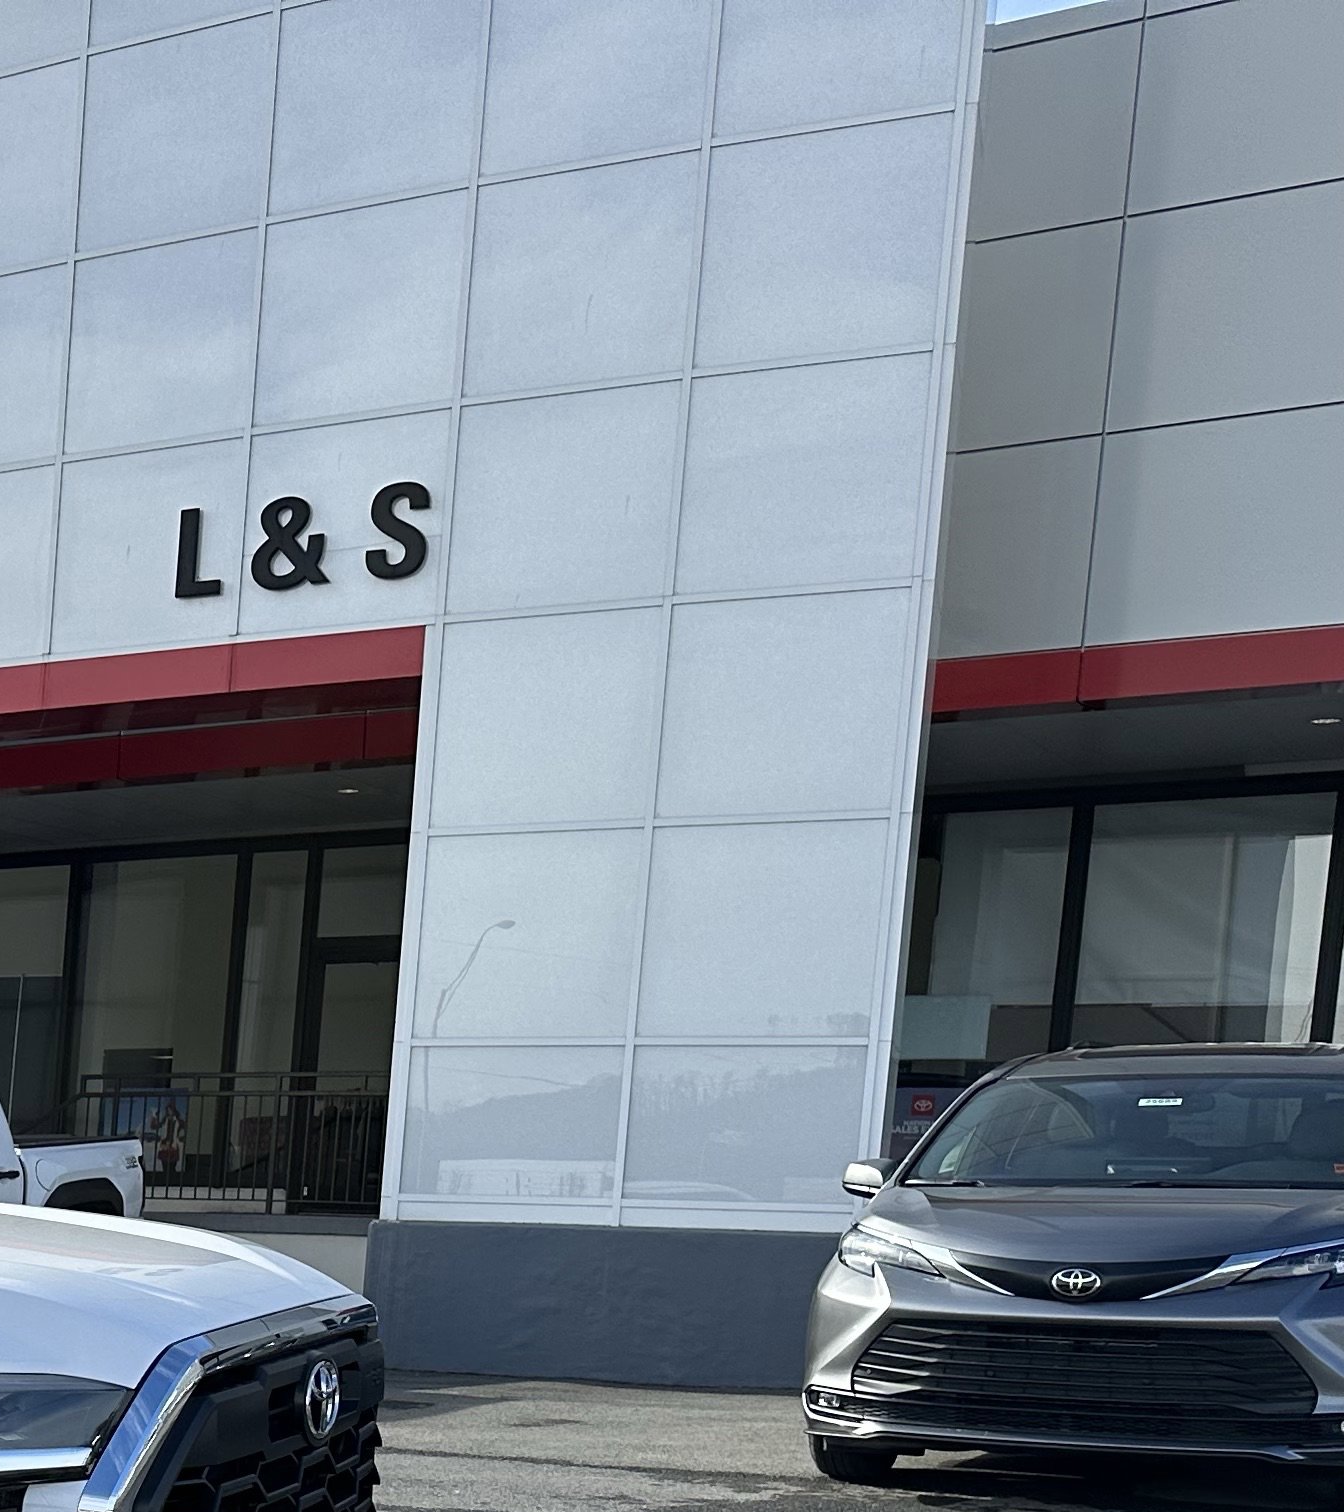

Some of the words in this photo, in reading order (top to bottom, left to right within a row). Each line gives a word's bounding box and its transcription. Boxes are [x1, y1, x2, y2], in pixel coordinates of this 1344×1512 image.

[174, 507, 222, 599] L
[250, 496, 331, 591] &
[365, 481, 431, 580] S
